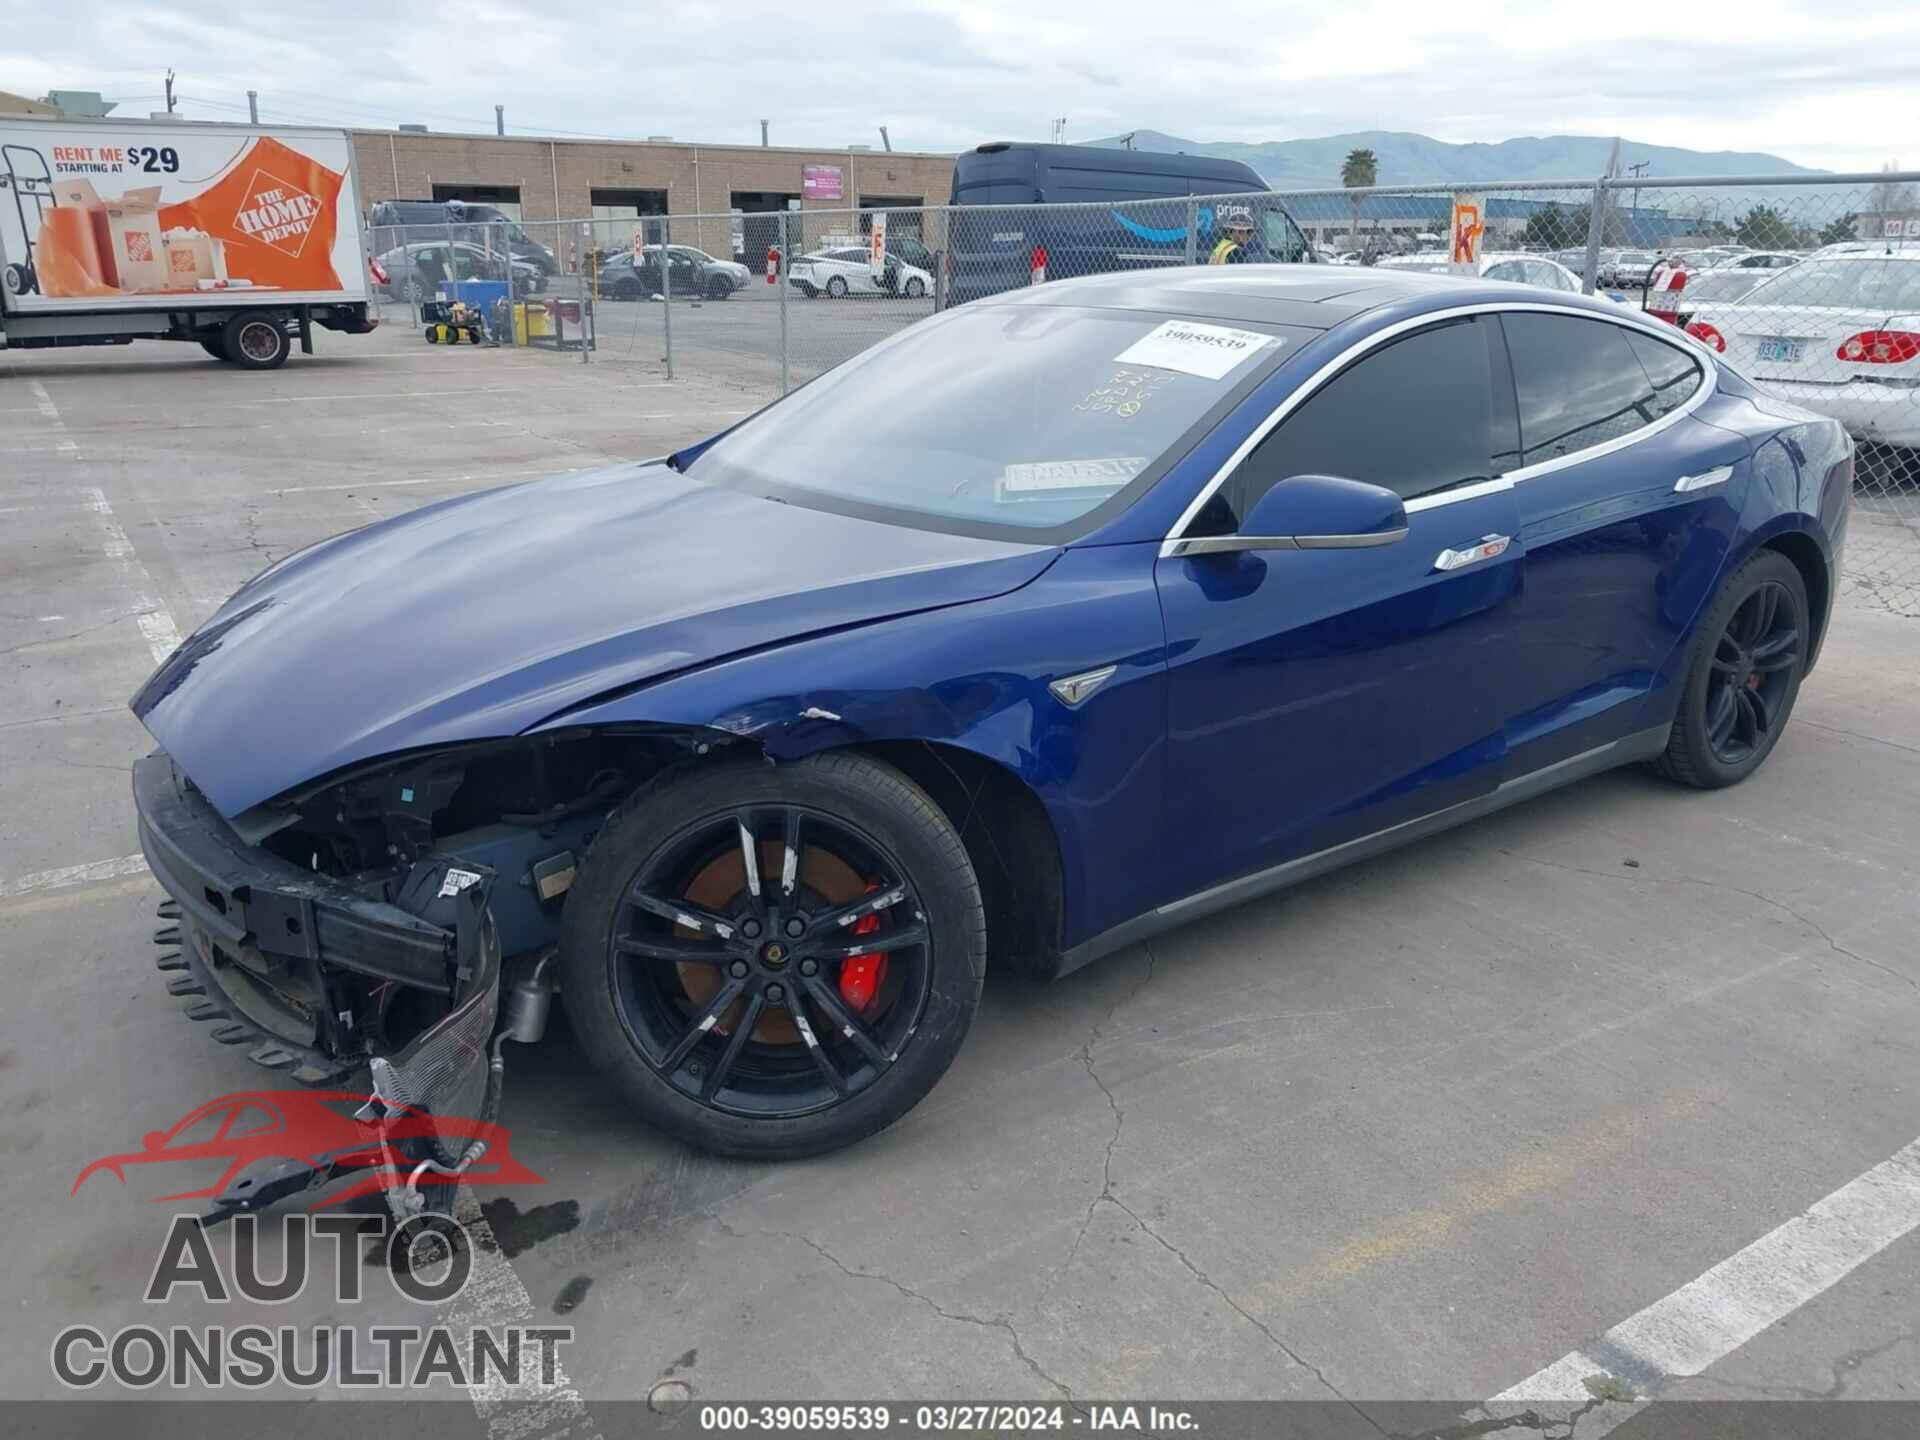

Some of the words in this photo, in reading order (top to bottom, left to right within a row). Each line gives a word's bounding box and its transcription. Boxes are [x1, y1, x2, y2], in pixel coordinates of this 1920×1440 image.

[53, 147, 95, 161] RENT
[99, 148, 124, 161] ME
[127, 146, 179, 173] $29
[56, 163, 108, 173] STARTING
[111, 164, 123, 173] AT
[254, 188, 286, 206] THE
[239, 194, 316, 233] HOME
[1216, 201, 1250, 220] prime
[261, 220, 311, 243] DEPOT
